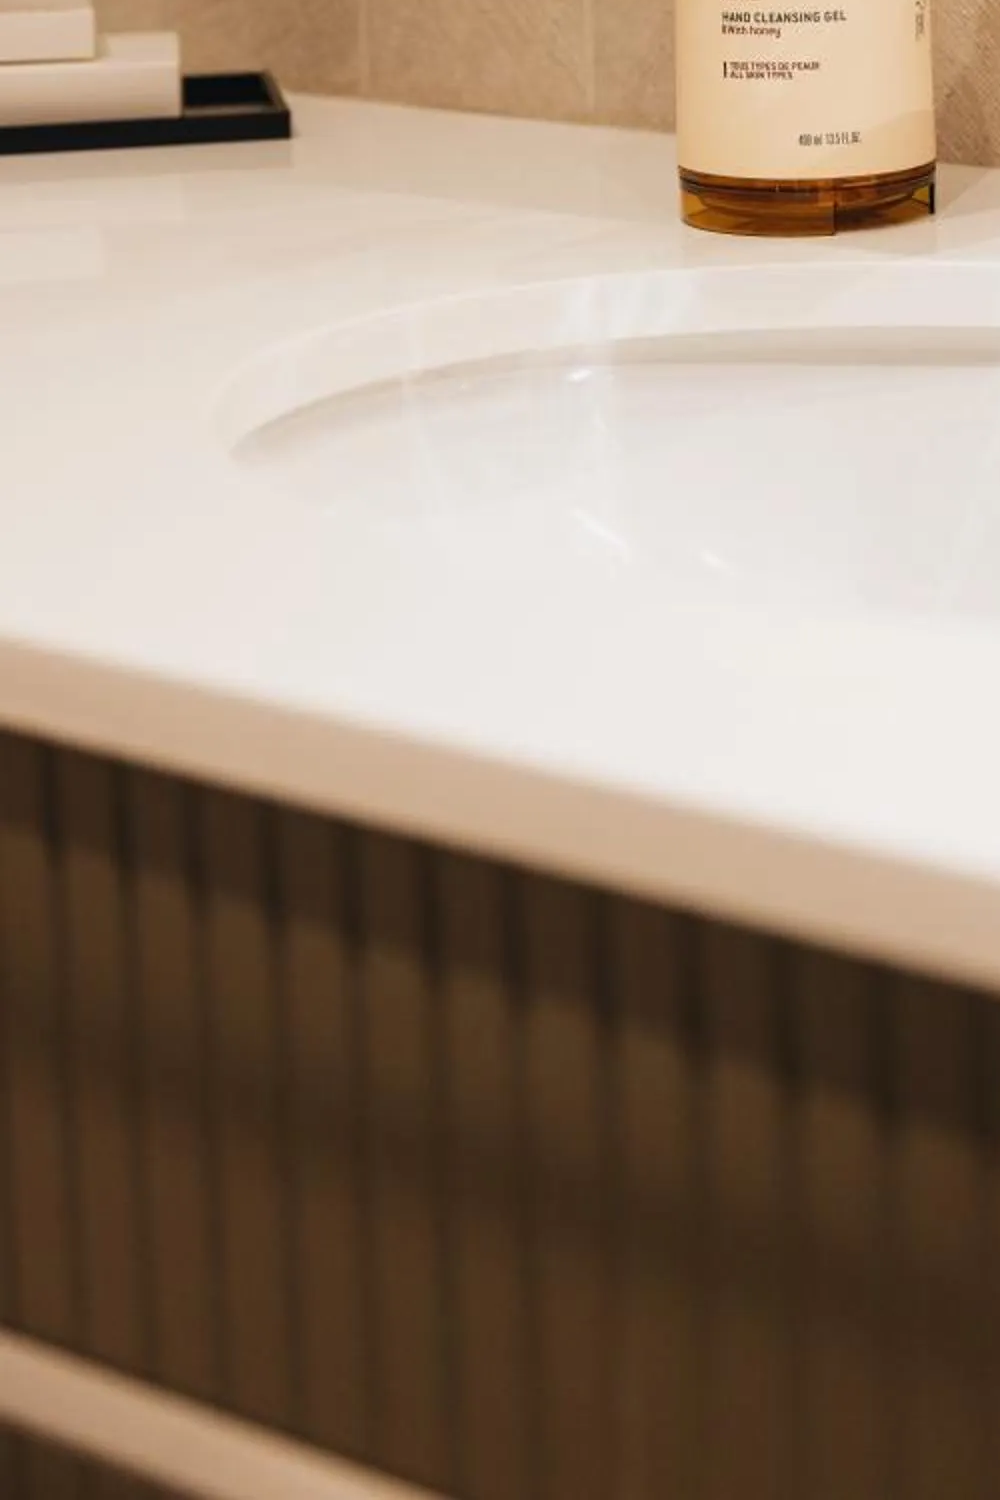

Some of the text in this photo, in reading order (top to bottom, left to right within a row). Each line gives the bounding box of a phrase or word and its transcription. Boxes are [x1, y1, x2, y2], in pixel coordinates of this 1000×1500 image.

[721, 9, 848, 23] HAND CLEANSING GEL
[749, 26, 781, 39] honey
